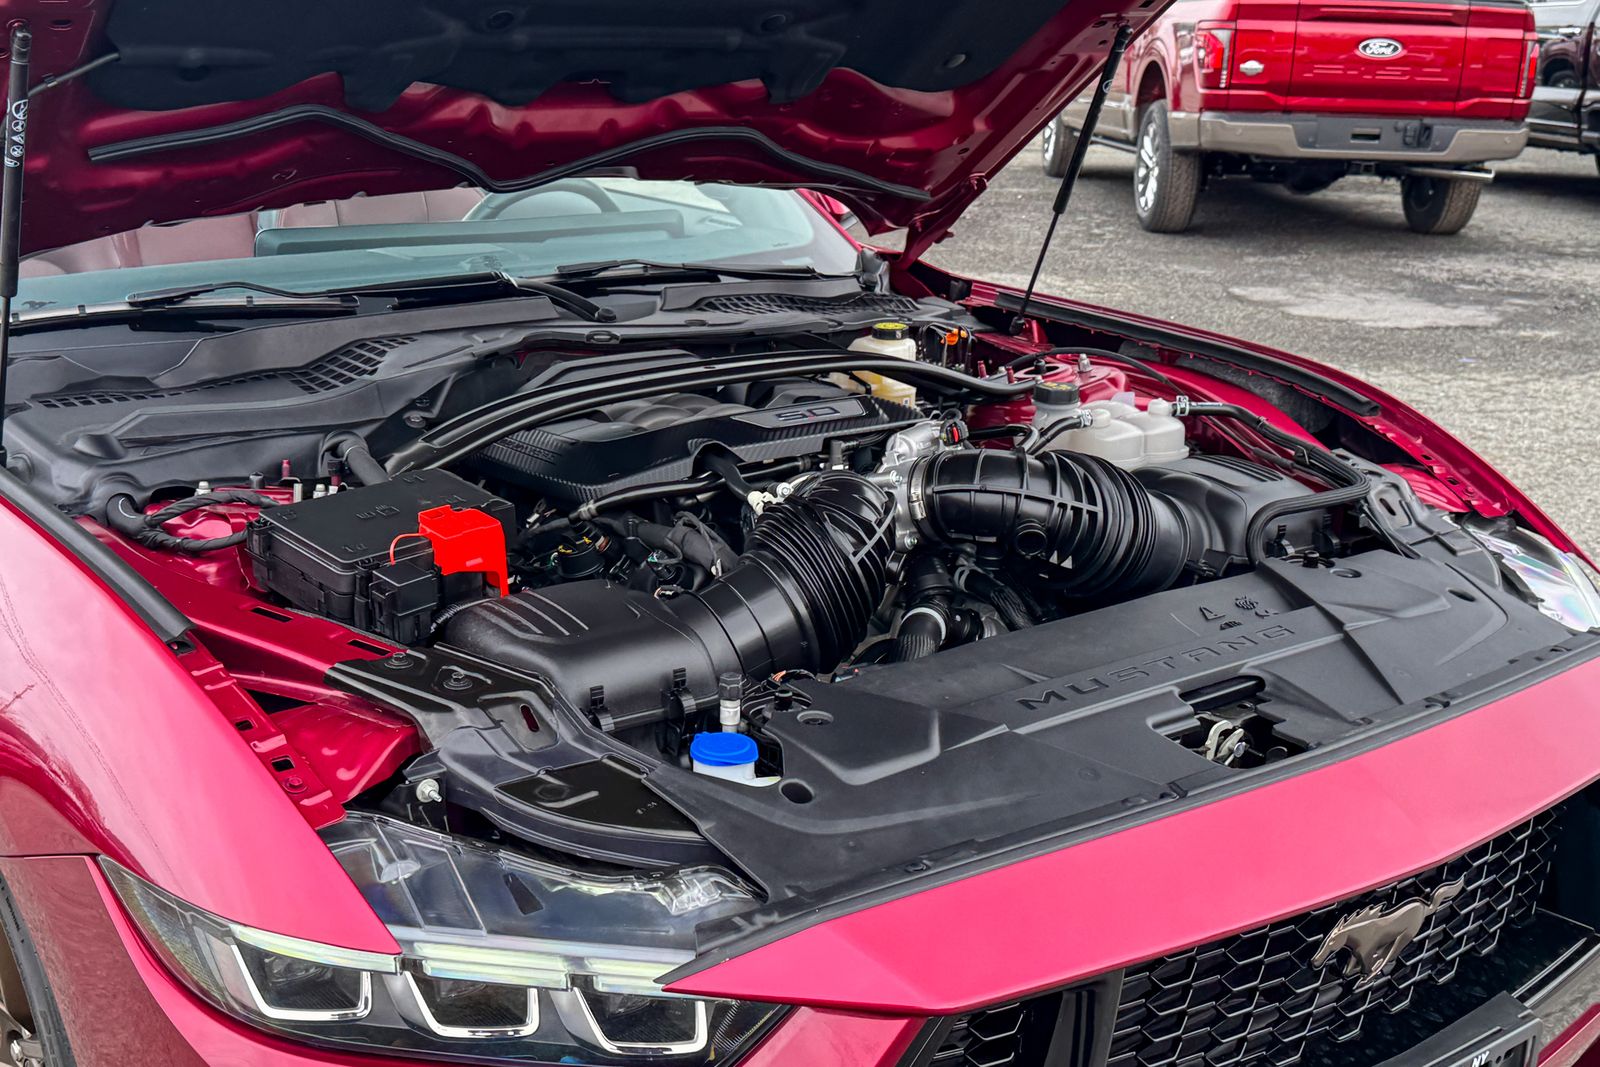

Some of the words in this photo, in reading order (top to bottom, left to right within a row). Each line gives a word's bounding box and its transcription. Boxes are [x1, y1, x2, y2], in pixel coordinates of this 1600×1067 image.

[1364, 41, 1397, 55] Ford
[775, 406, 840, 421] 5.0
[1016, 624, 1295, 711] MUSTANG
